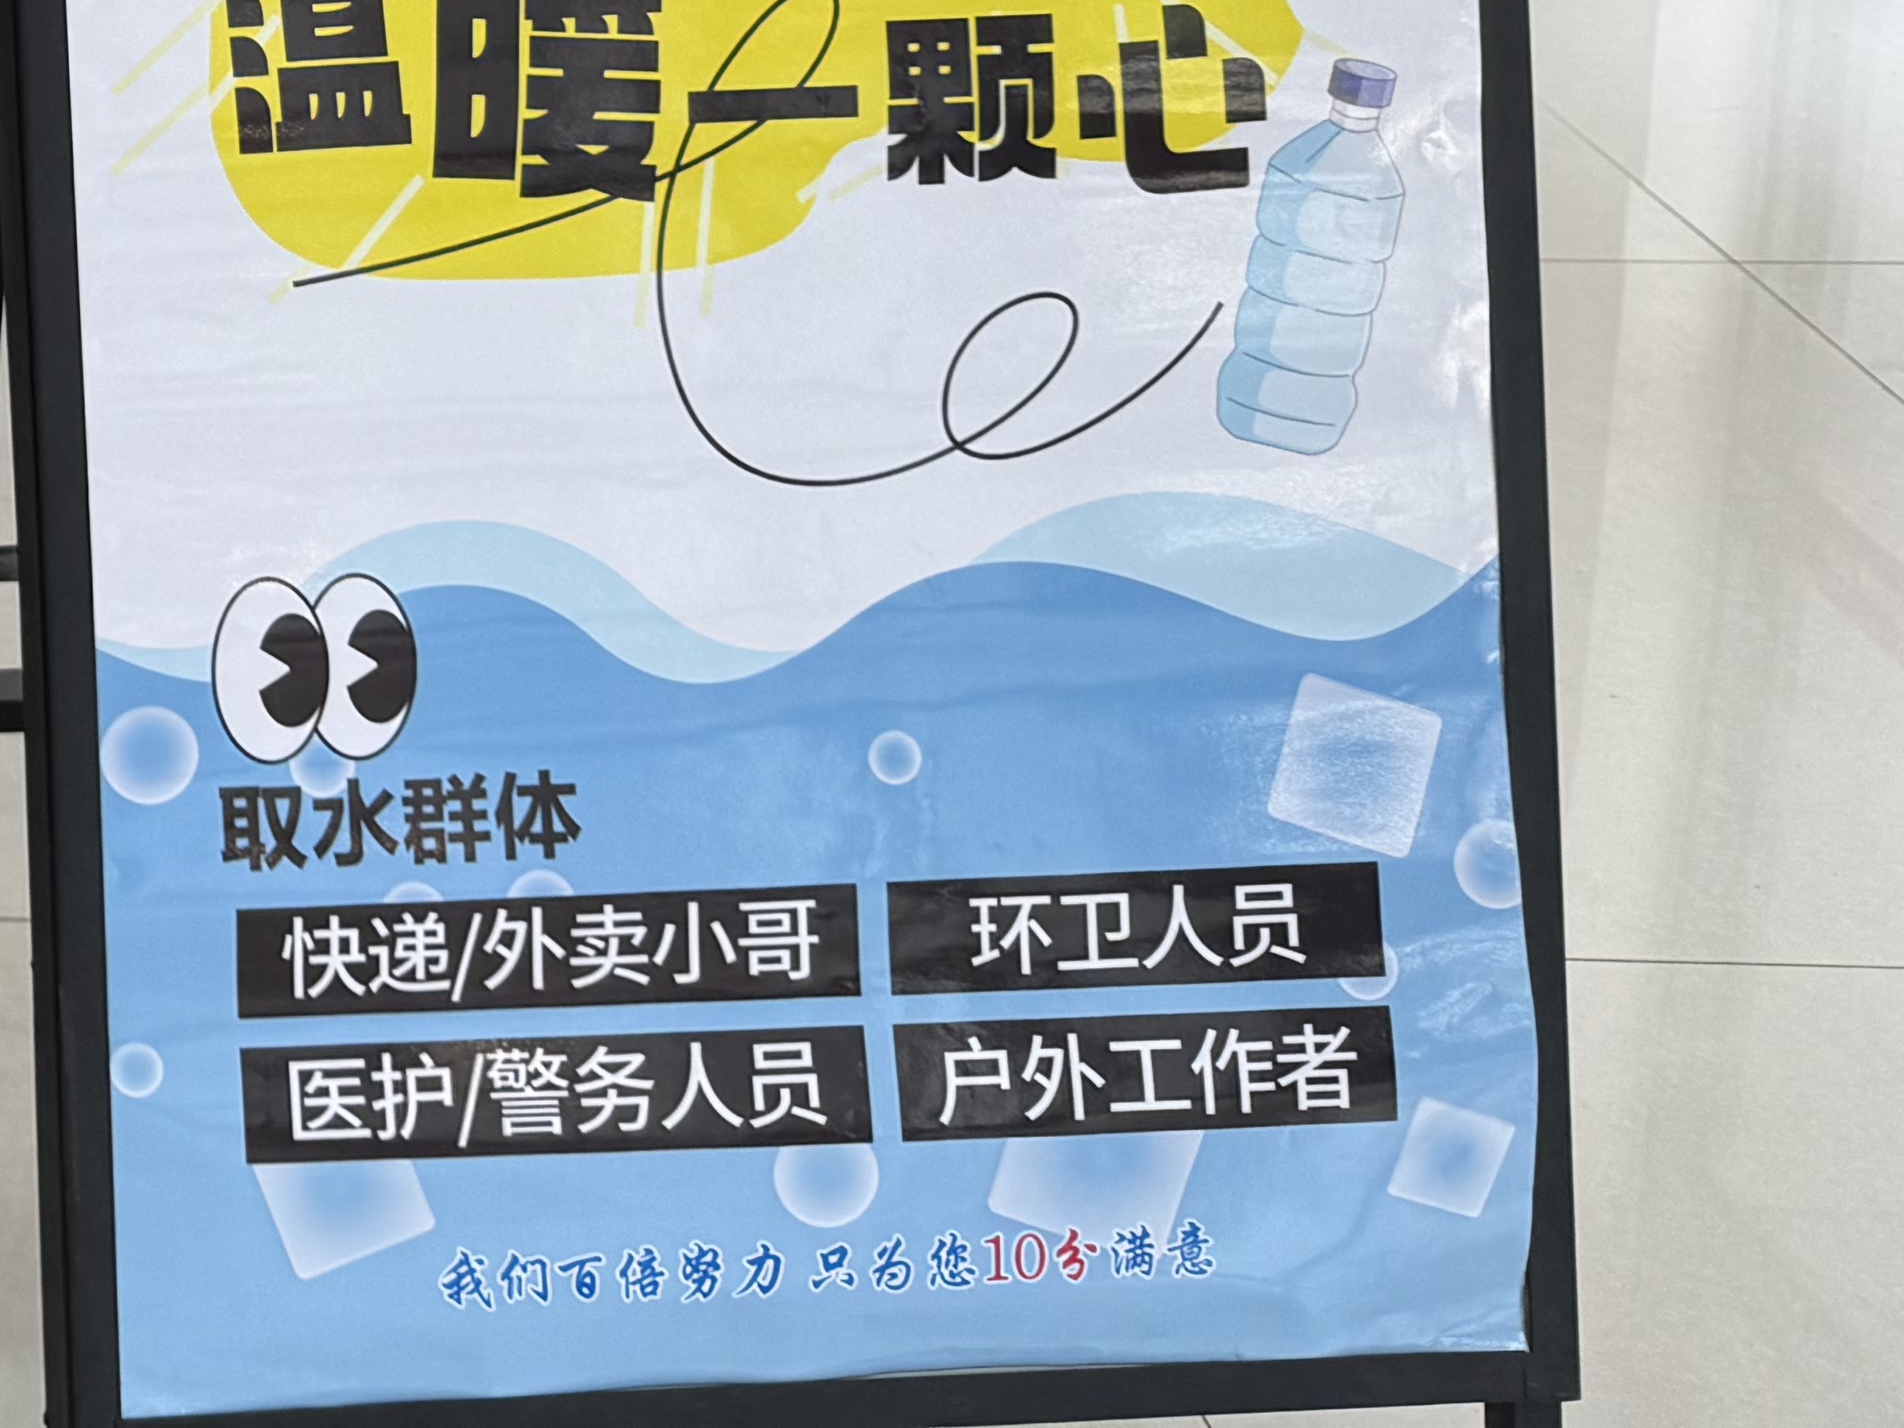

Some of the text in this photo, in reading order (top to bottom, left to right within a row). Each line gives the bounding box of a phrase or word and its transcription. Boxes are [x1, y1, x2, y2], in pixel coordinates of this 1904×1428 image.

[217, 771, 580, 873] 取水群体
[282, 900, 821, 1004] 快递/外卖小哥
[967, 884, 1305, 979] 环卫人员
[286, 1041, 830, 1150] 医护/警务人员
[938, 1021, 1357, 1125] 户外工作者
[438, 1219, 1217, 1313] 我们百倍努力 只为您10分满意
